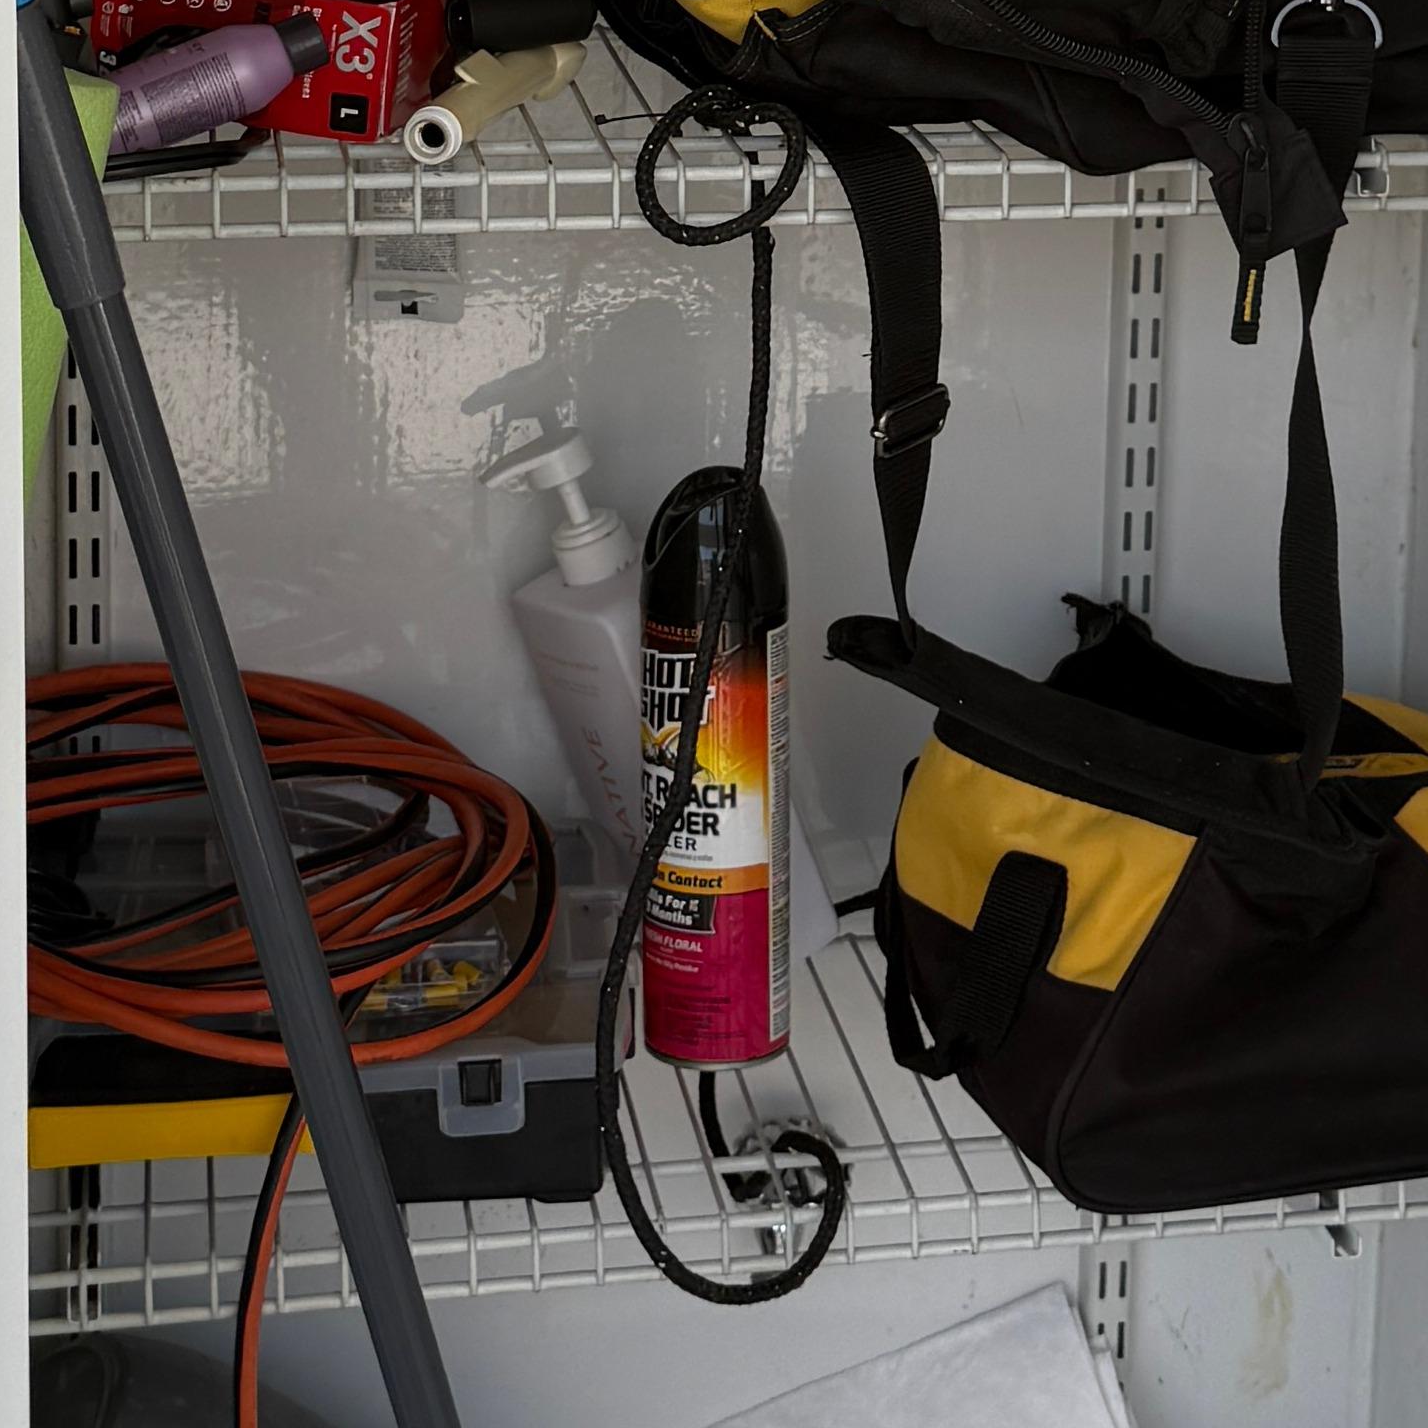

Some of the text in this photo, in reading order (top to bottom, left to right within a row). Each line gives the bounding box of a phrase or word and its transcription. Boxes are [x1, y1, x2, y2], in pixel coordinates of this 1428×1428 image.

[335, 10, 383, 74] X3
[339, 107, 359, 118] L
[643, 652, 695, 690] HOT
[656, 774, 737, 809] RACH
[644, 797, 720, 837] SPDER
[667, 871, 724, 889] Contact
[665, 894, 687, 909] For
[652, 903, 694, 926] Months
[664, 935, 704, 953] FLORAL
